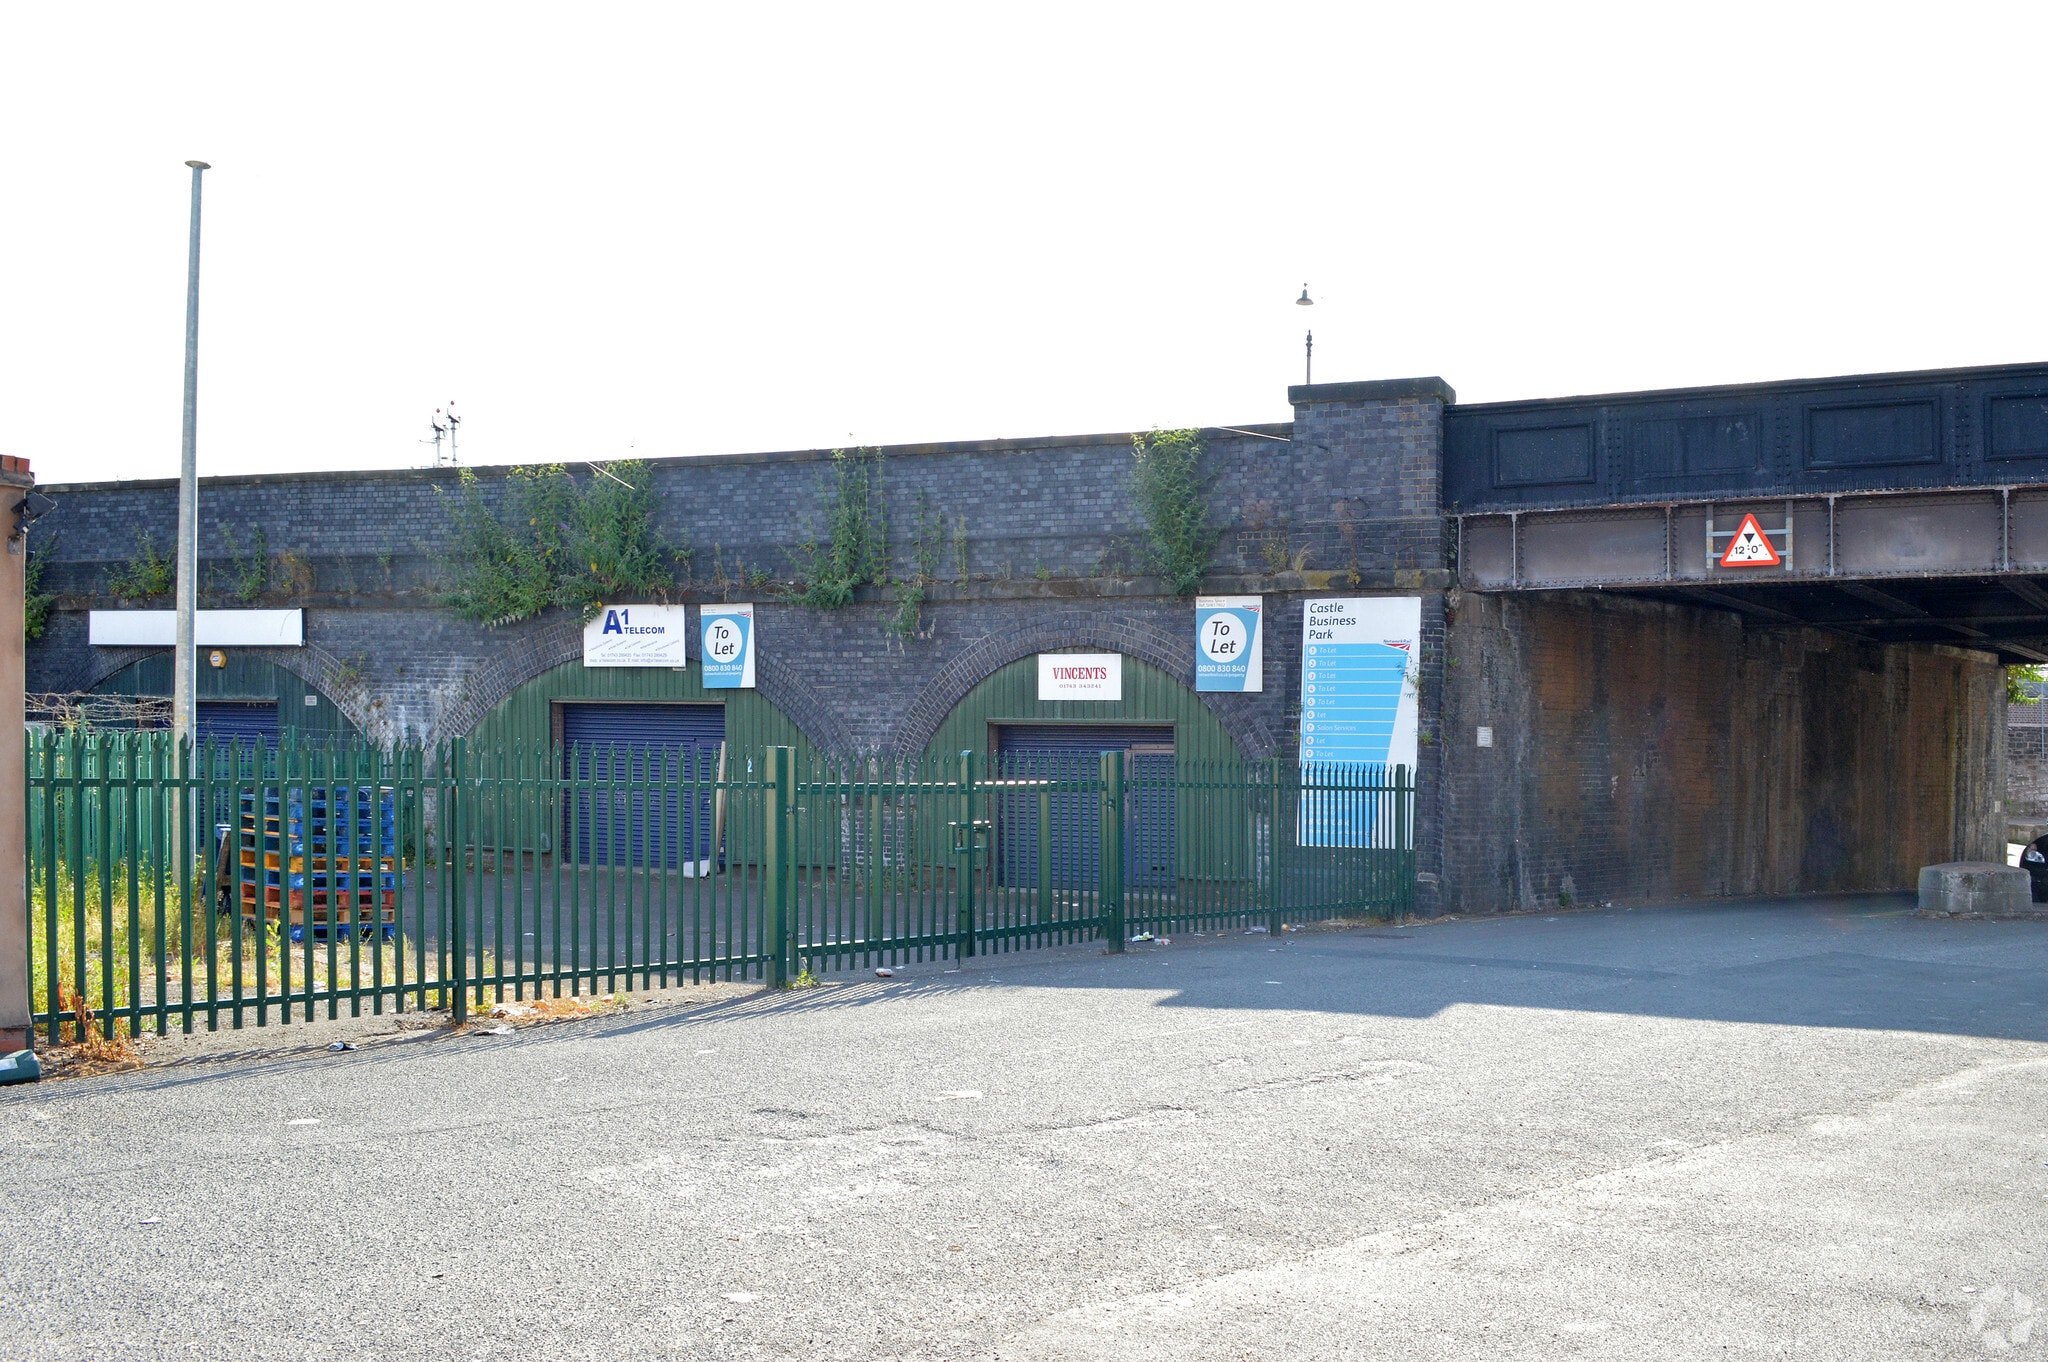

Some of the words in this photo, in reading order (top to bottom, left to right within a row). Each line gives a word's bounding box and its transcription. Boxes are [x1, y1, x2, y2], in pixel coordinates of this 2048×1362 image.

[1309, 602, 1344, 613] Castle
[602, 608, 629, 634] A1
[1309, 616, 1357, 626] Business
[624, 626, 665, 634] TELECOM
[714, 626, 729, 639] To
[1212, 621, 1230, 636] To
[1308, 629, 1333, 640] Park
[714, 642, 735, 655] Let
[1211, 639, 1236, 654] Let
[1053, 667, 1107, 680] VINCENTS
[1198, 664, 1216, 672] 0800
[1217, 664, 1230, 672] 830
[1232, 664, 1246, 672] 840
